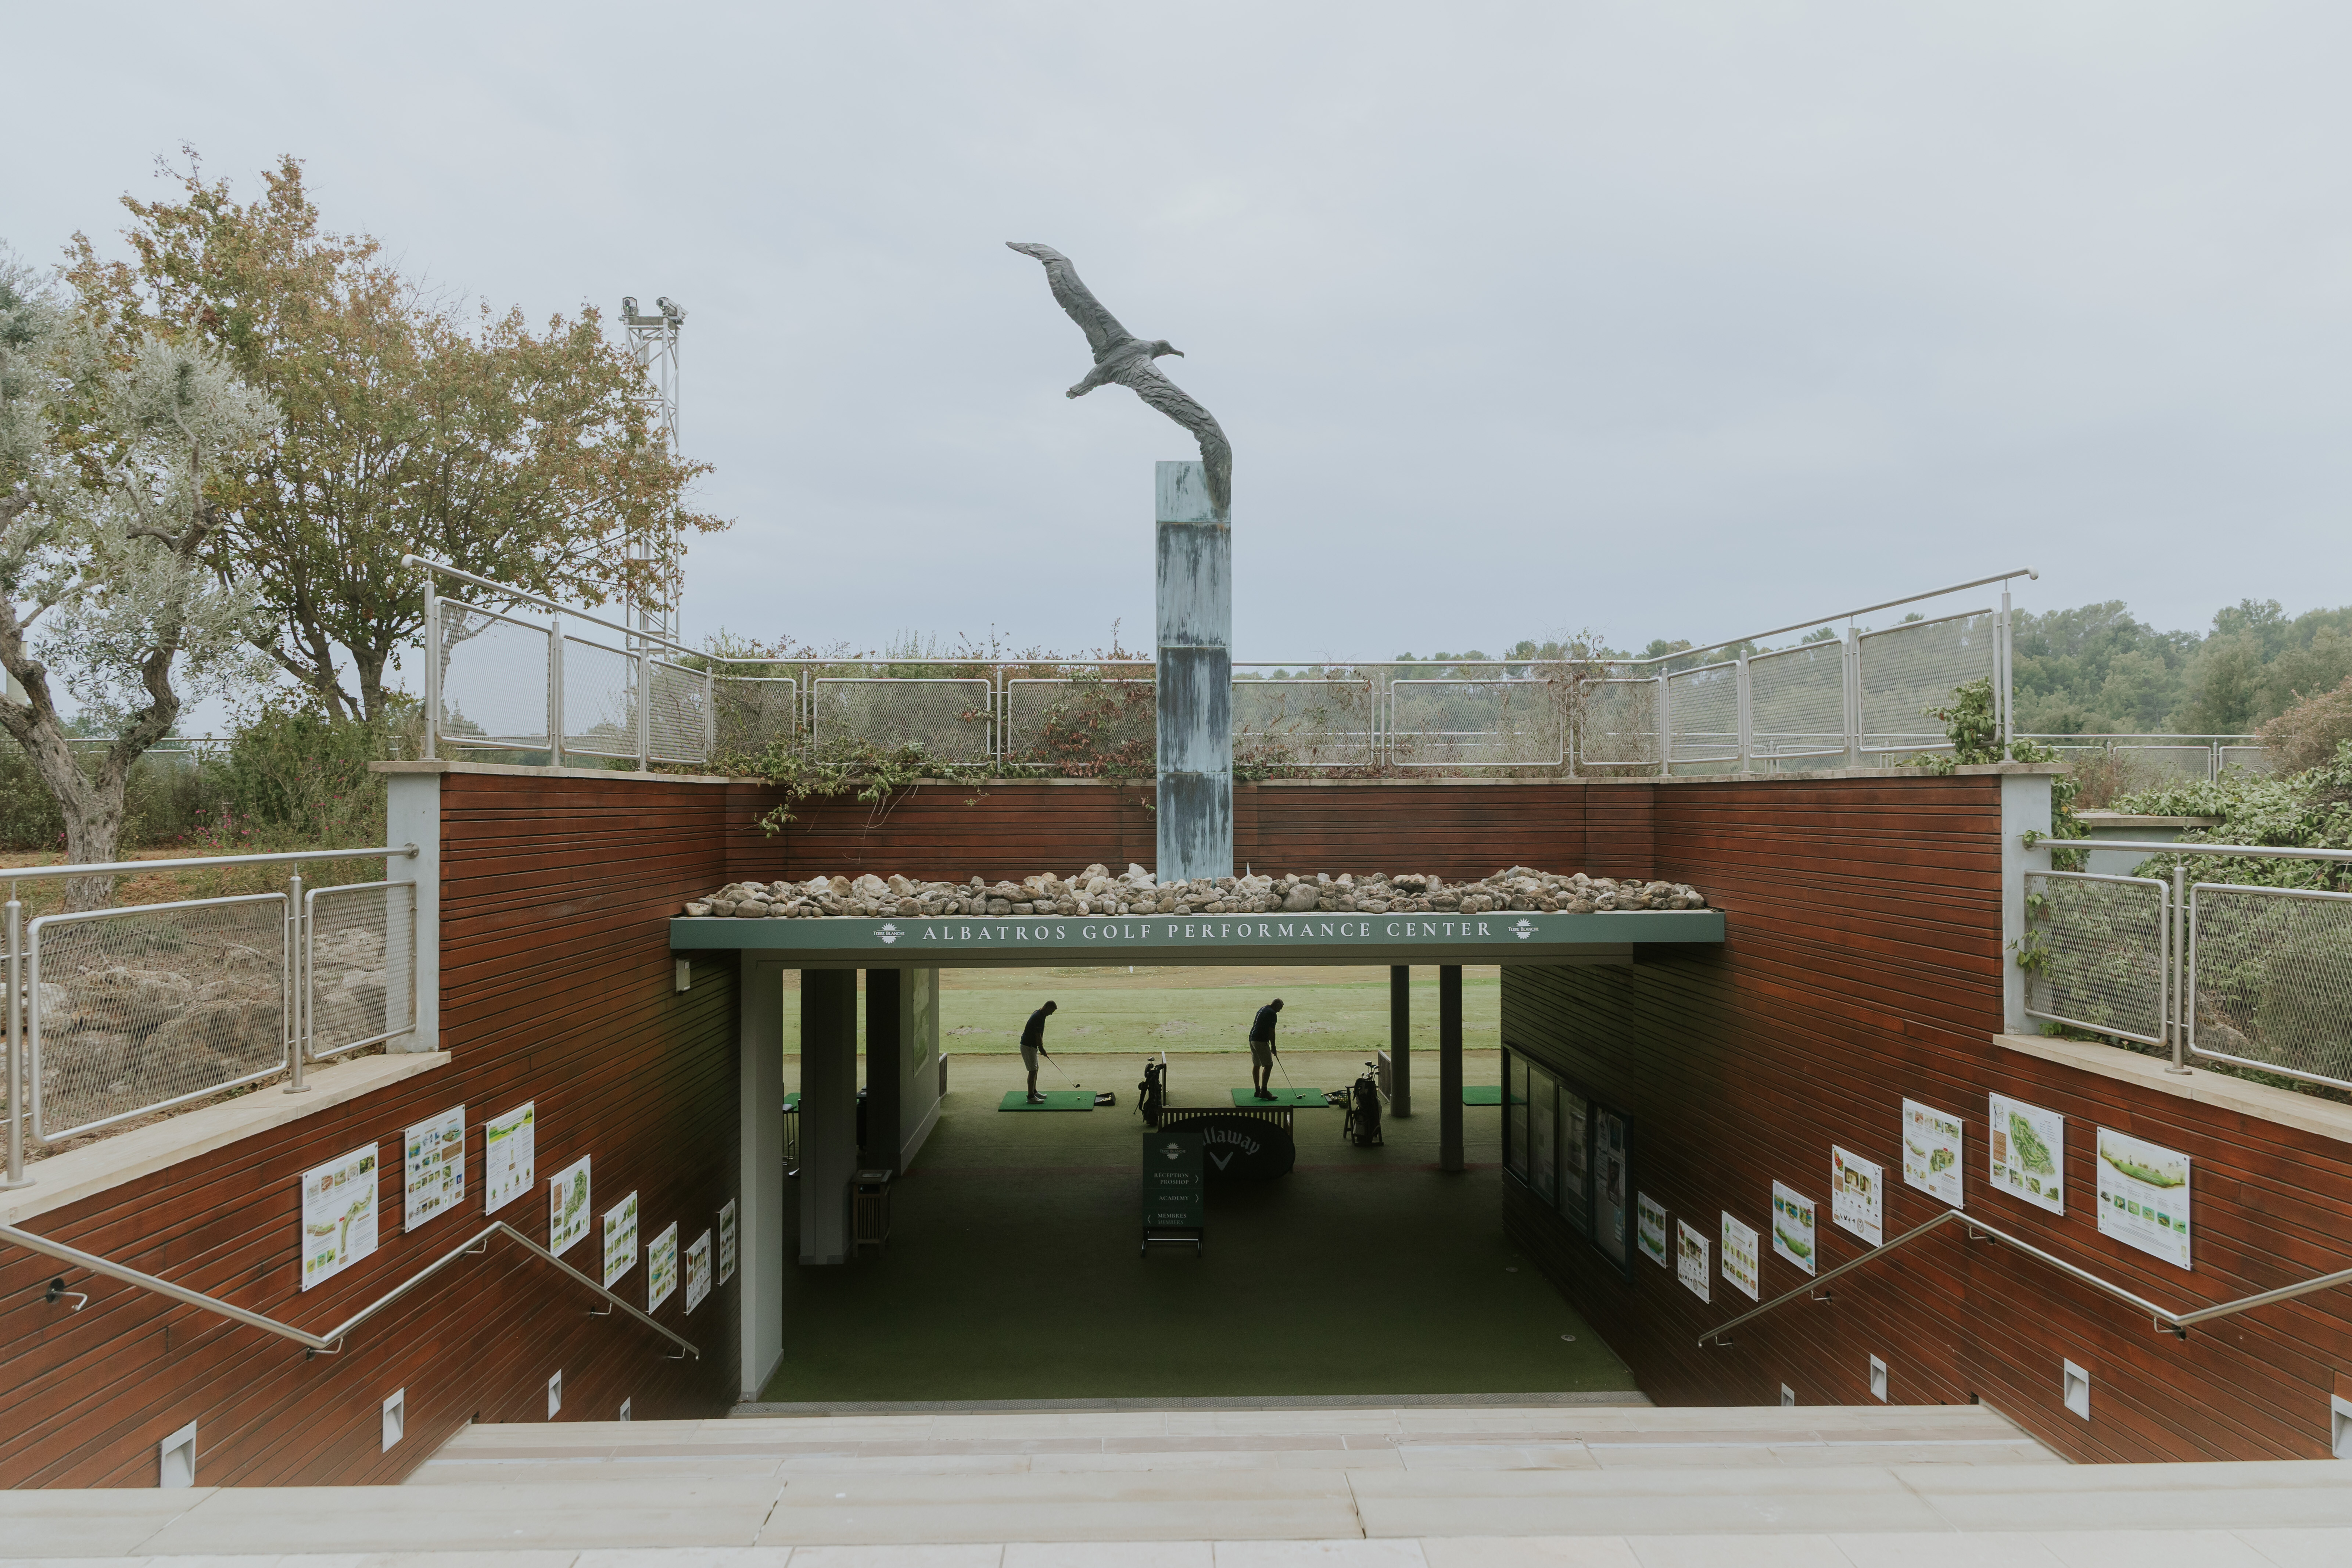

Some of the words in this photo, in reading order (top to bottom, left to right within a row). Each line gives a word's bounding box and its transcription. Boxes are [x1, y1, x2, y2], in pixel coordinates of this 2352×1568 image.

[922, 926, 1065, 940] ALBATROS
[1083, 925, 1150, 939] GOLF
[1168, 923, 1370, 938] PERFORMANCE
[1387, 922, 1491, 936] CENTER
[1203, 1126, 1260, 1155] llaway
